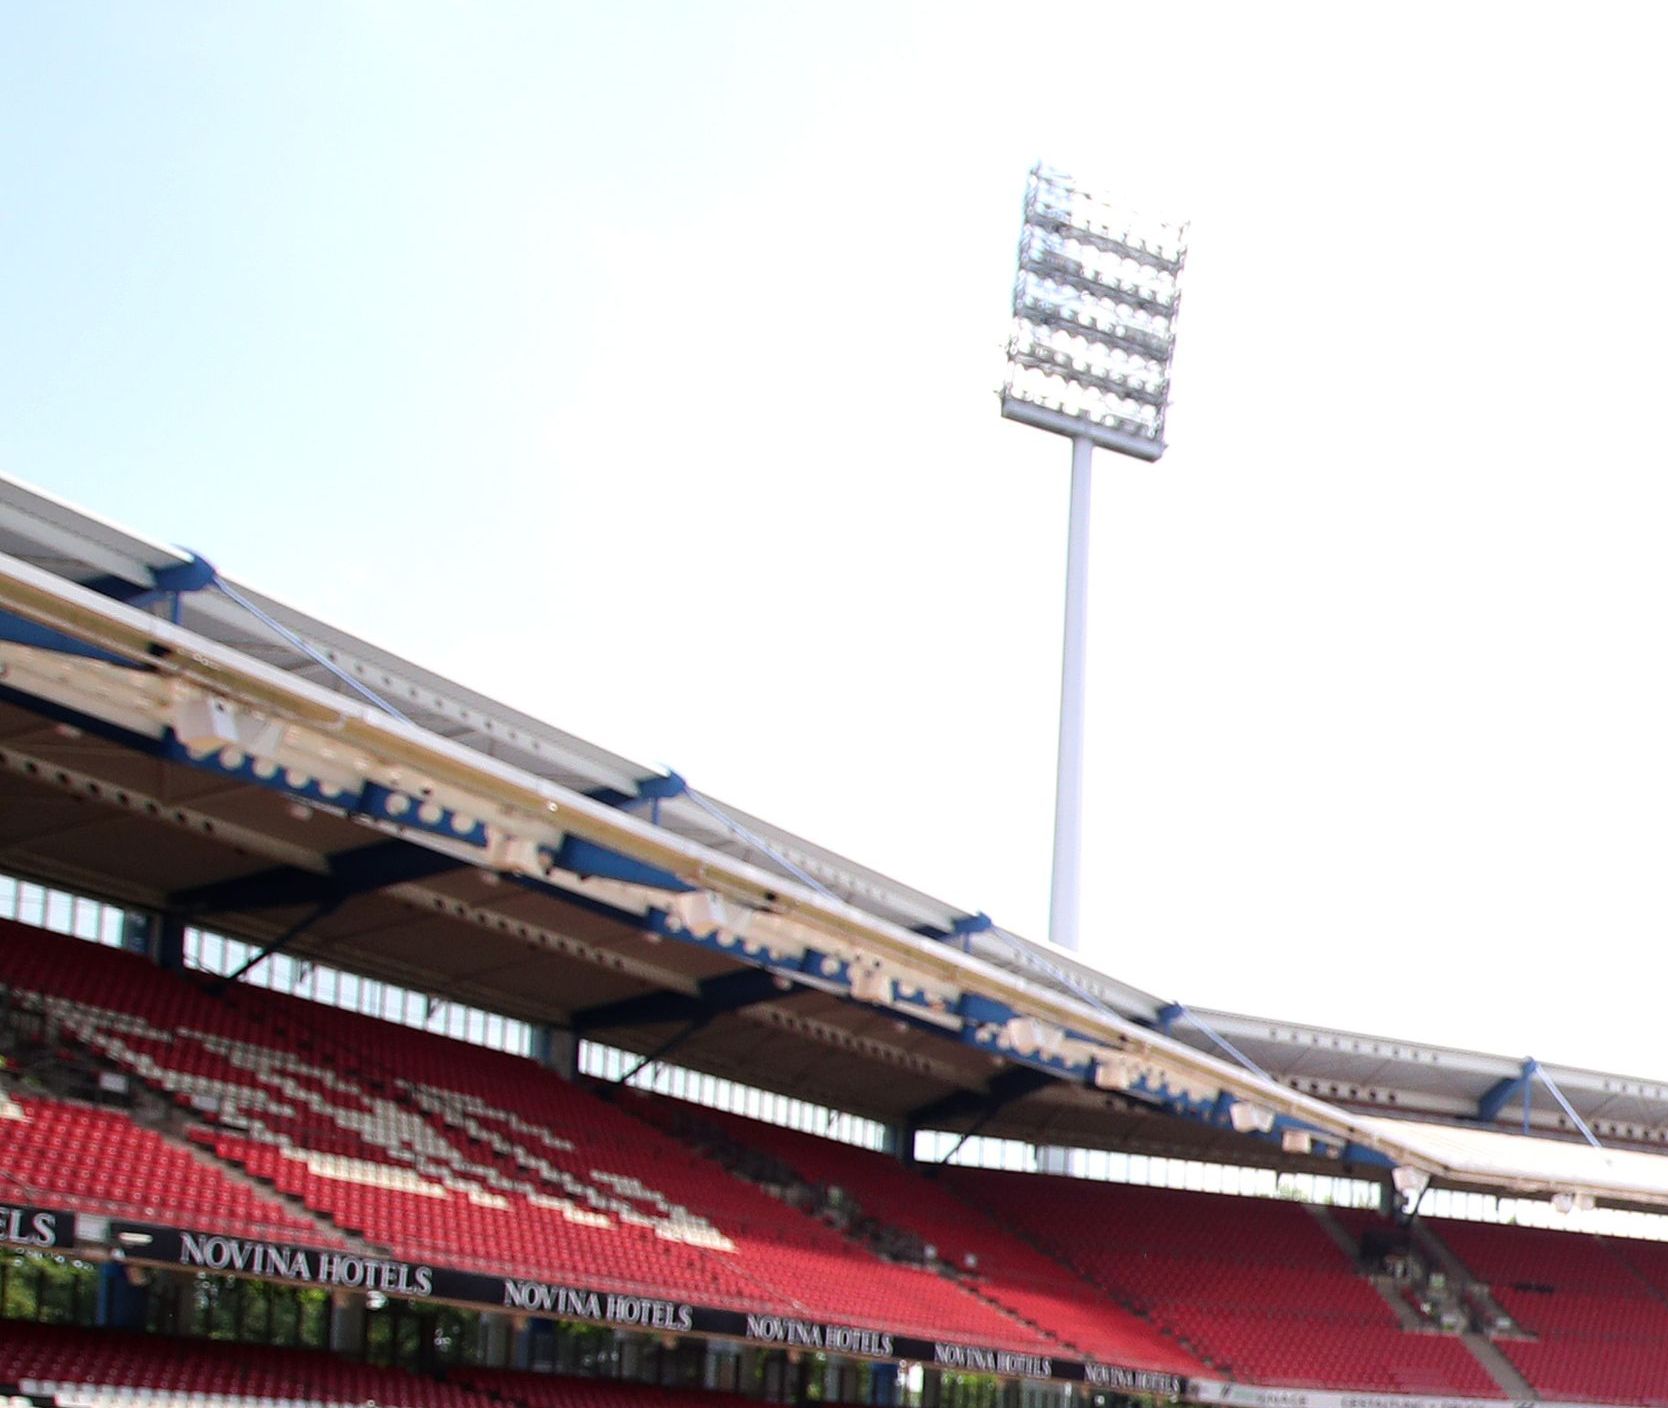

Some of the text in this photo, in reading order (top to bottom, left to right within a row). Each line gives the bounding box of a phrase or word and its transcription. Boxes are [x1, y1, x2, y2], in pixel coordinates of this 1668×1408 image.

[180, 1231, 434, 1297] NOVINA HOTELS
[504, 1278, 693, 1332] NOVINA HOTELS
[746, 1314, 893, 1356] NOVINA HOTELS
